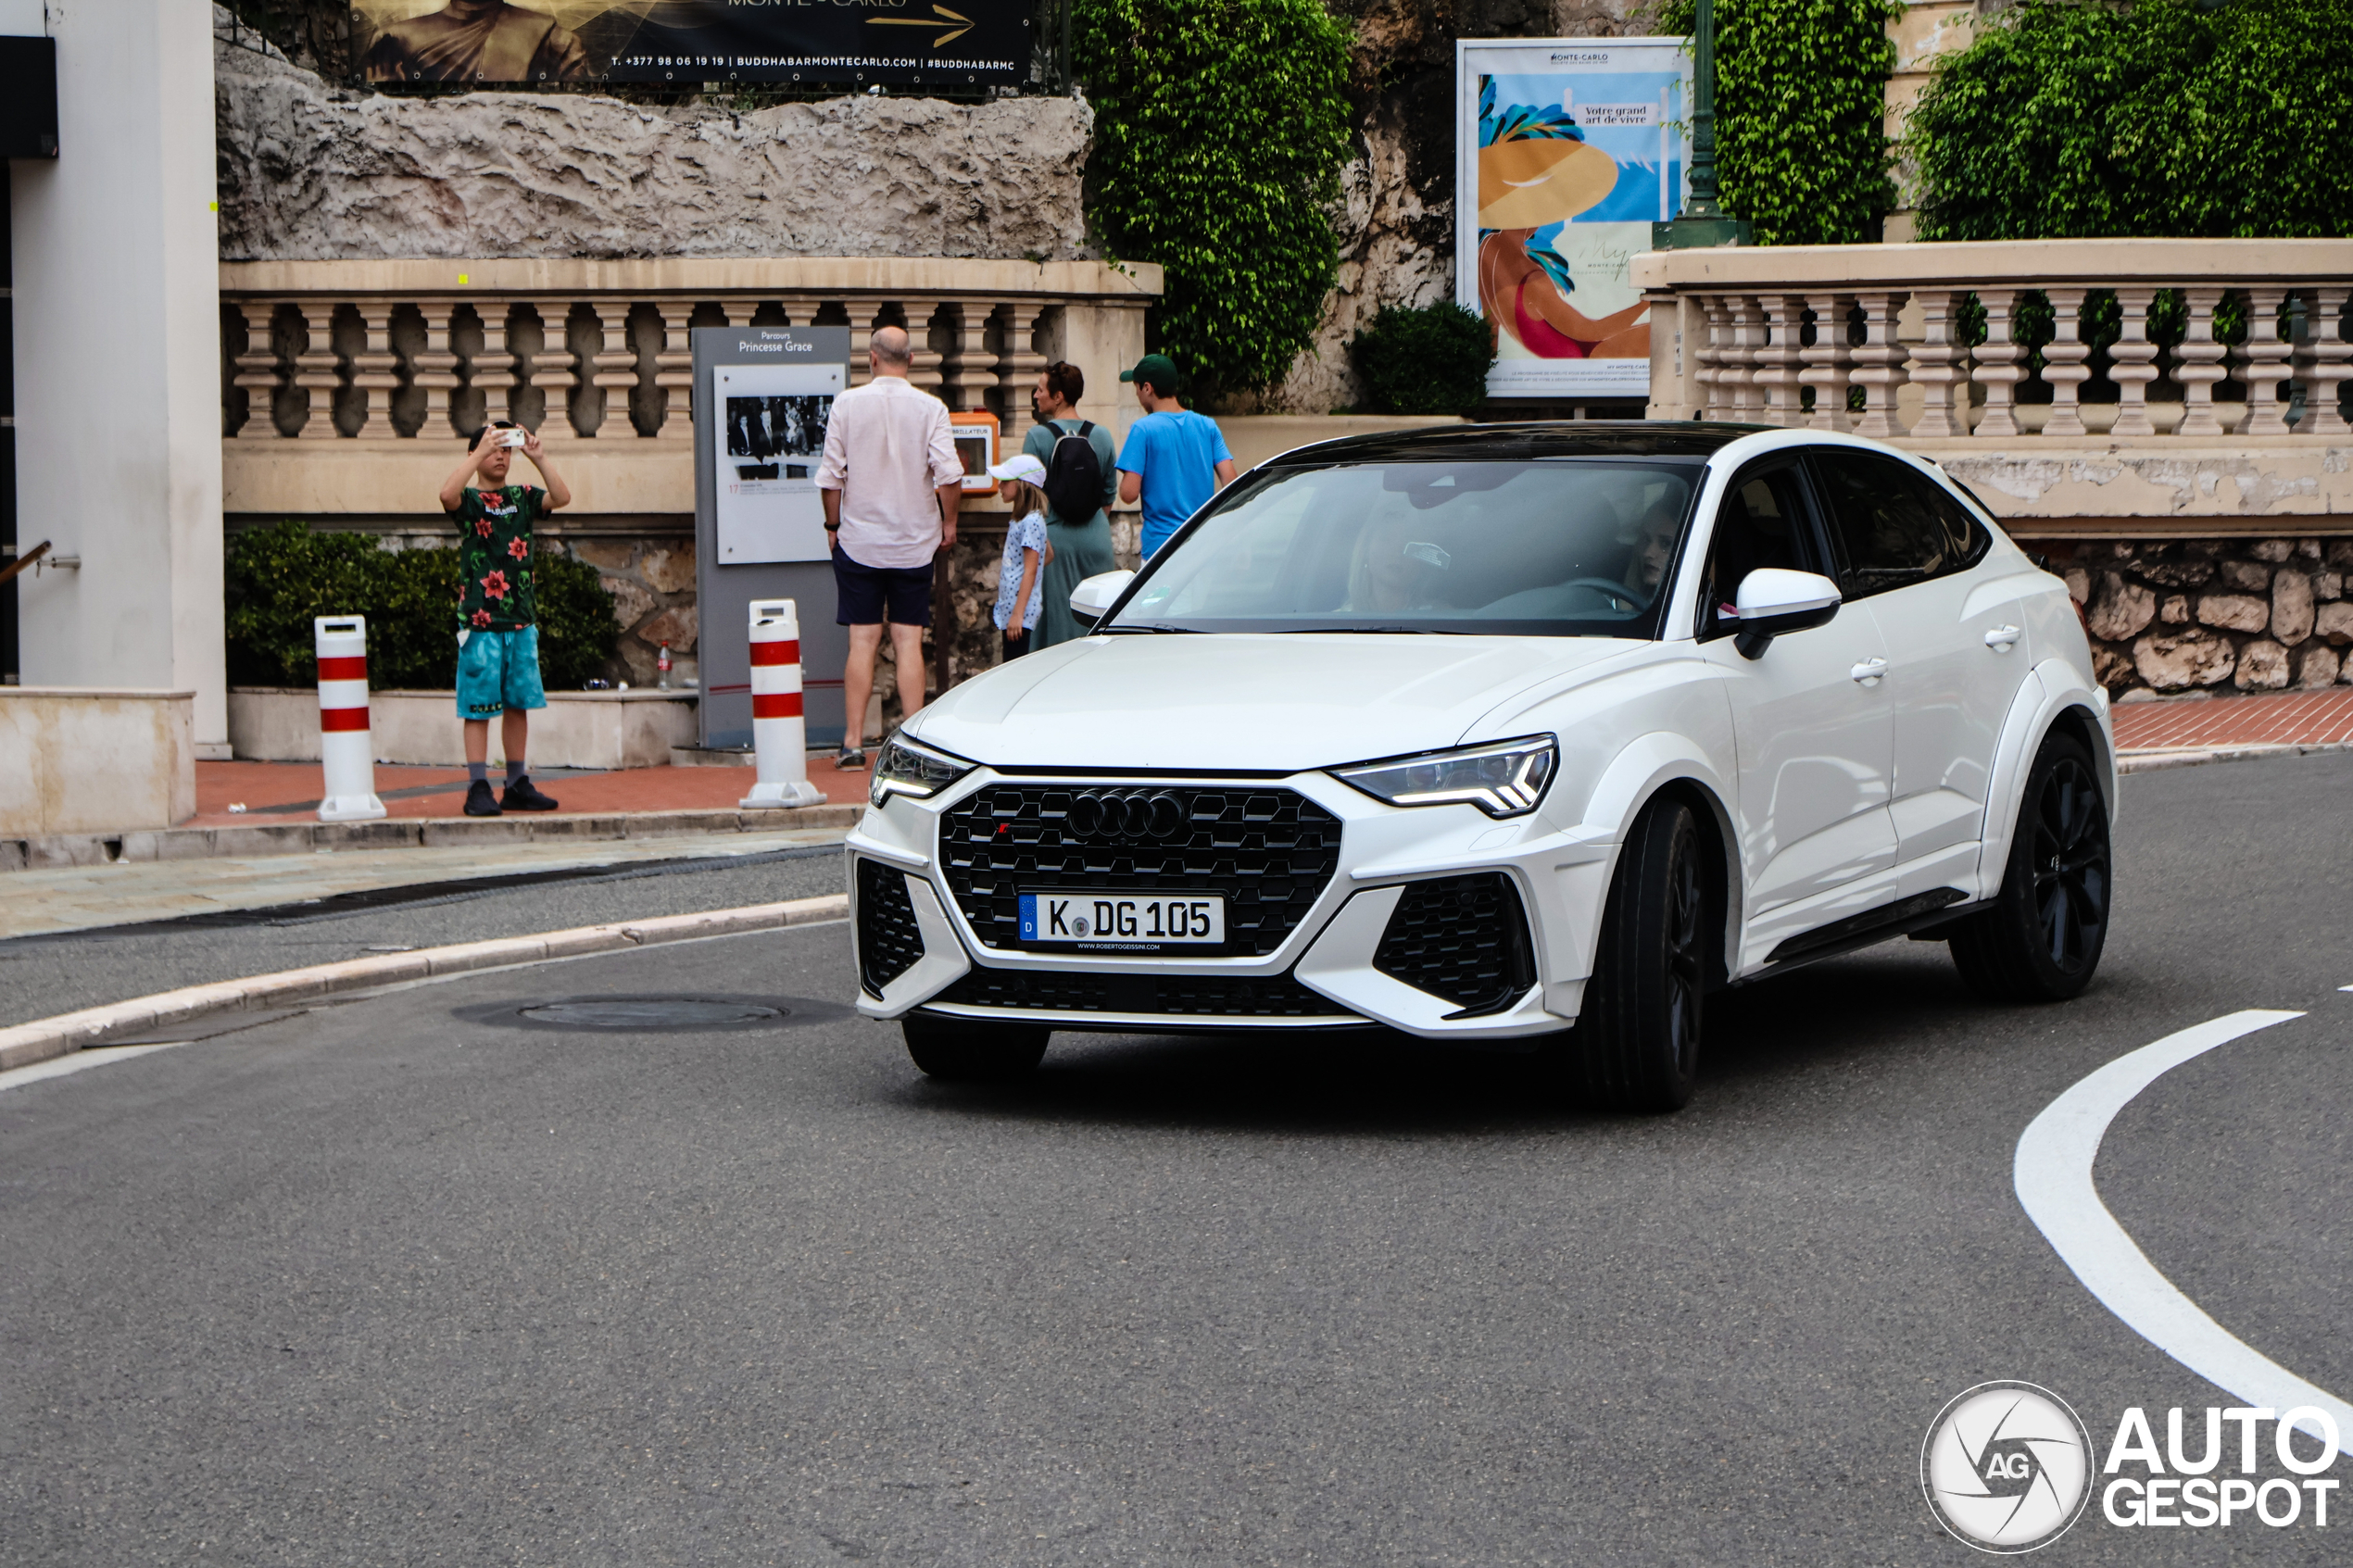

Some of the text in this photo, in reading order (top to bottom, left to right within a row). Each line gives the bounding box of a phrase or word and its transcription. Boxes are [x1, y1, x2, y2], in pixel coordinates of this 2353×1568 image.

[611, 57, 621, 66] T.
[625, 56, 653, 66] +377
[658, 56, 672, 66] 98
[676, 56, 691, 66] 06
[696, 56, 708, 66] 19
[712, 56, 724, 66] 19
[737, 56, 916, 68] BUDDHABARMONTECARLO.COM
[927, 59, 1014, 70] #BUDDHABARMC
[1585, 106, 1646, 117] Votre grand
[1585, 116, 1646, 124] art de vivre
[761, 332, 790, 340] Parcours
[739, 341, 812, 352] Princesse Grace
[729, 484, 738, 494] 17
[1050, 900, 1211, 937] K DG 105
[1025, 922, 1033, 933] D
